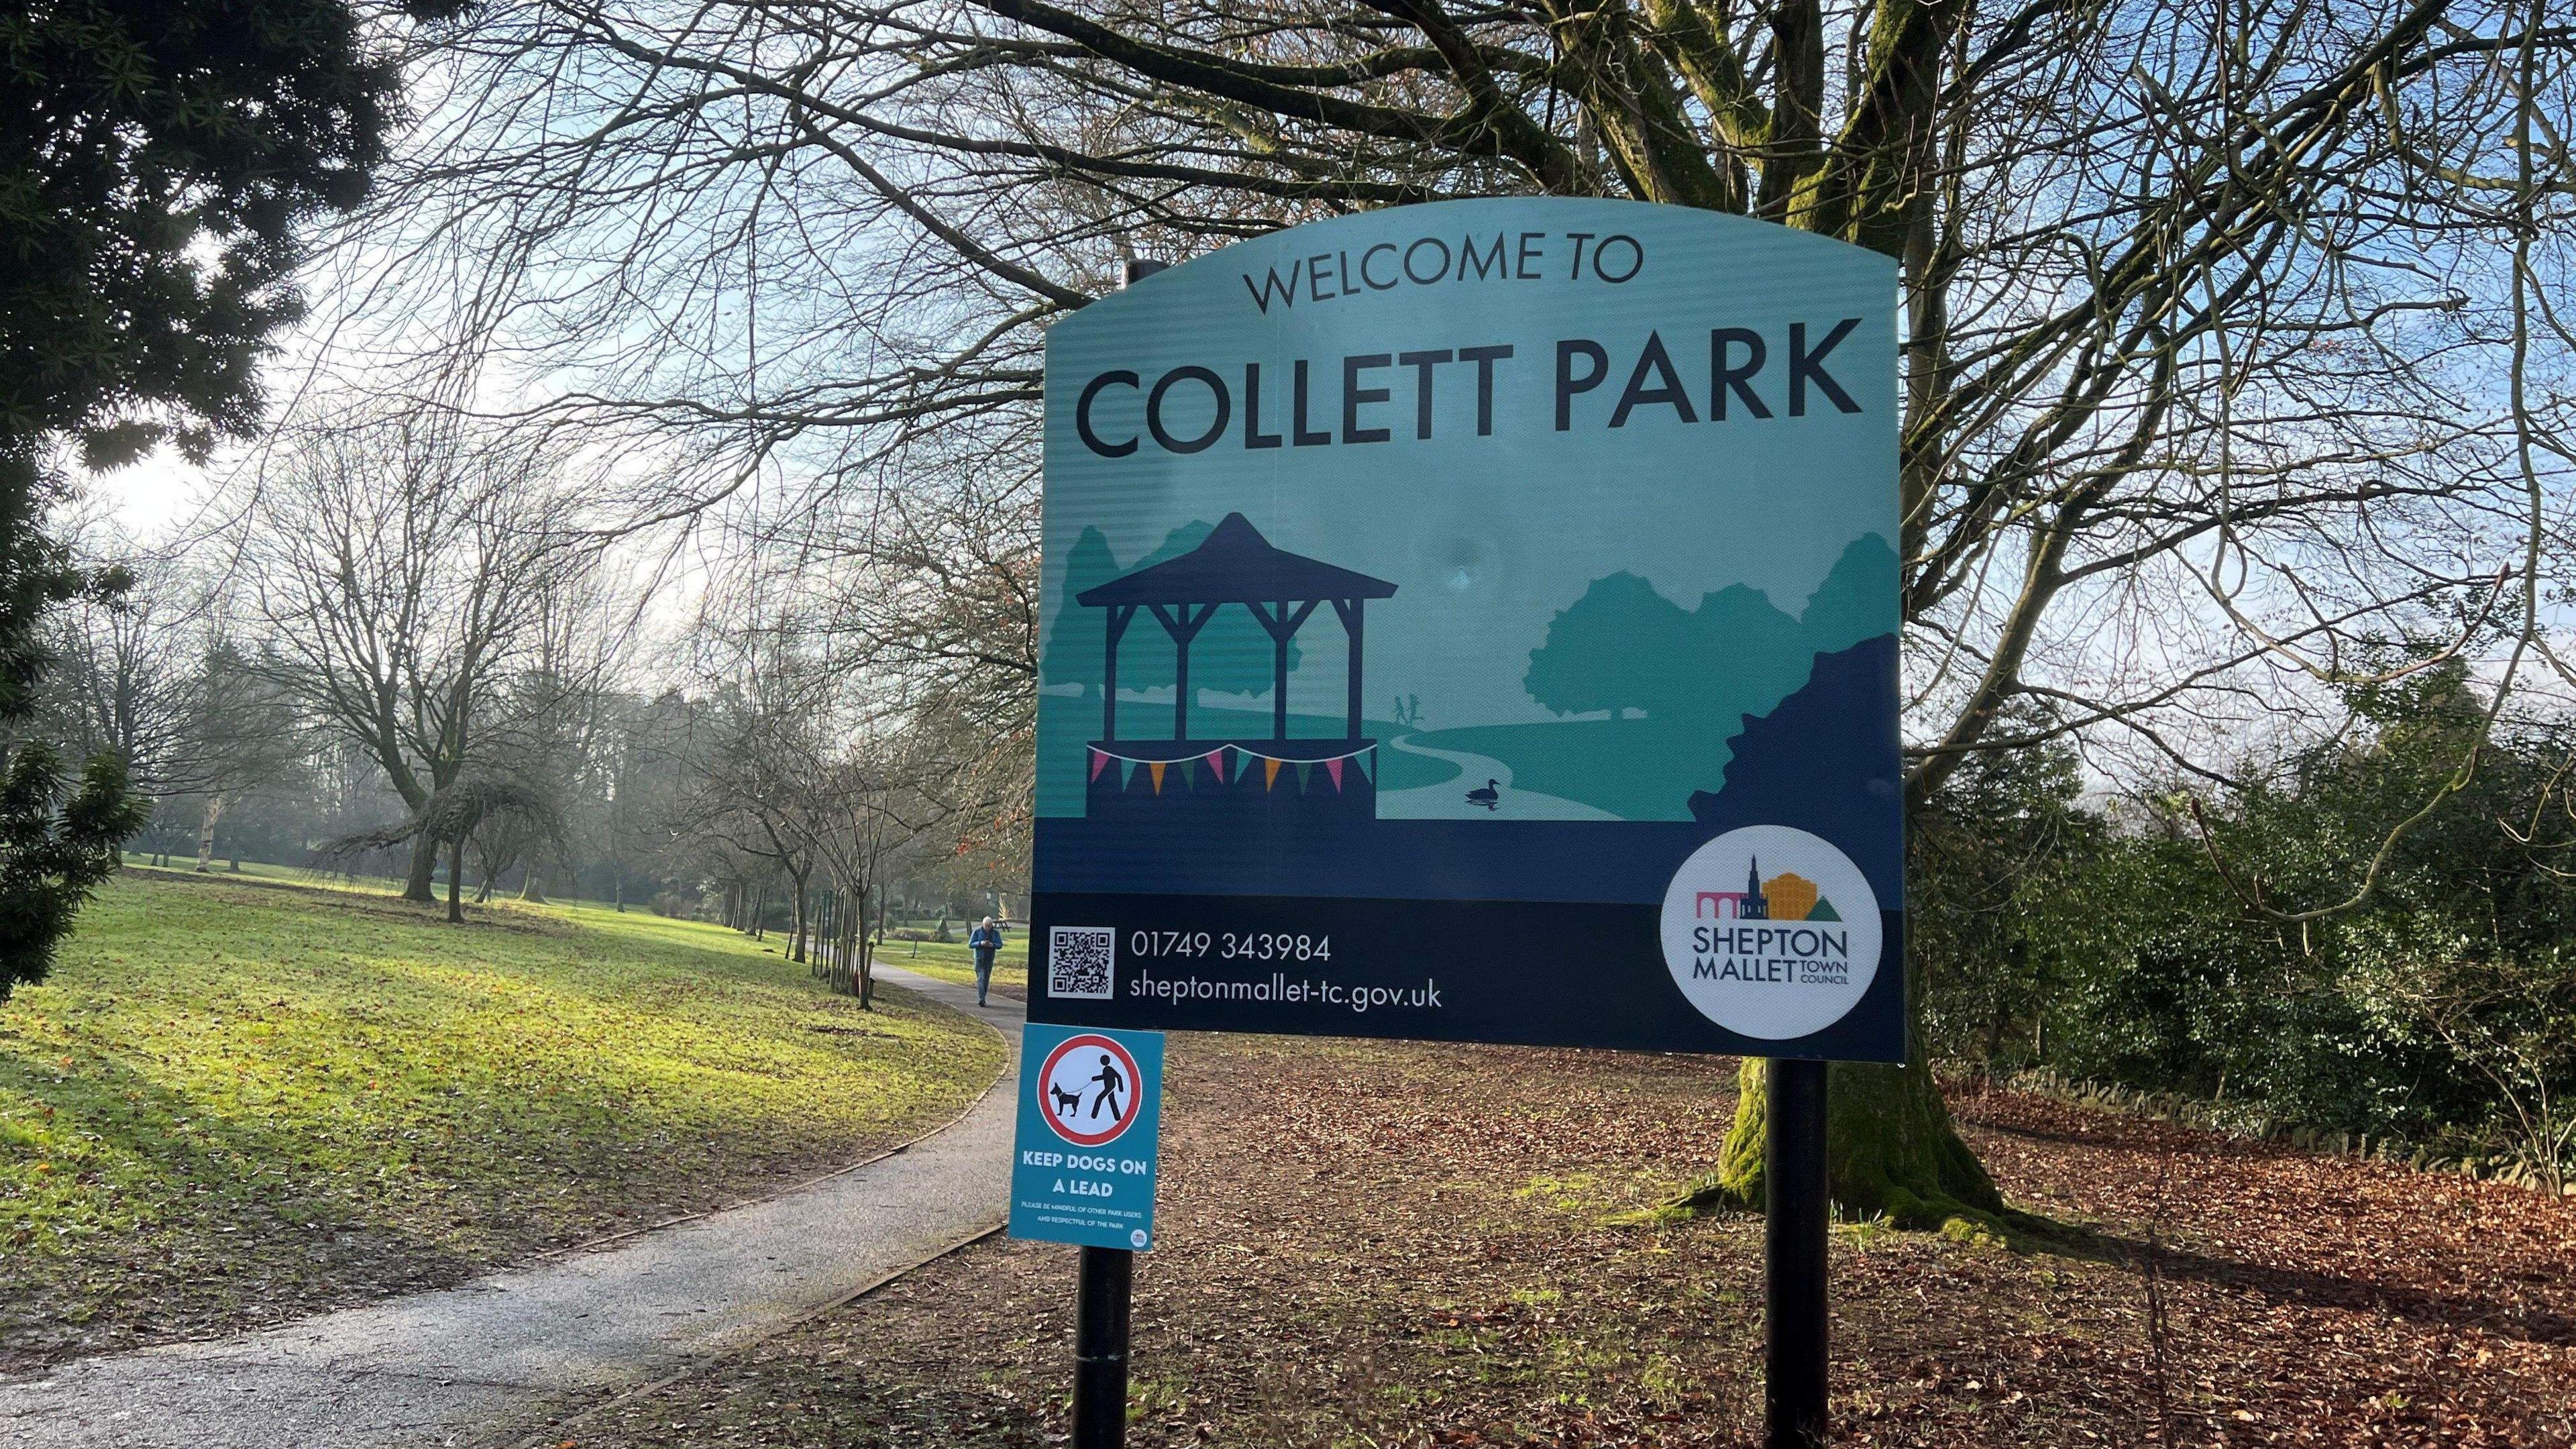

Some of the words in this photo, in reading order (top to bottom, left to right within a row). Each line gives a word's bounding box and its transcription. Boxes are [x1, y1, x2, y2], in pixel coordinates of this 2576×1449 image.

[1242, 231, 1546, 316] WELCOME
[1566, 232, 1644, 284] TO
[1075, 344, 1514, 458] COLLETT
[1555, 317, 1863, 433] PARK
[1131, 930, 1211, 957] 01749
[1221, 932, 1331, 961] 343984
[1692, 926, 1848, 958] SHEPTON
[1693, 956, 1797, 983] MALLET
[1799, 960, 1848, 974] TOWN
[1801, 974, 1849, 985] COUNCIL
[1130, 969, 1442, 1012] sheptonmallet-tc.gov.uk
[1023, 1150, 1063, 1167] KEEP
[1067, 1155, 1116, 1173] DOGS
[1120, 1159, 1147, 1176] ON
[1053, 1178, 1065, 1193] A
[1069, 1179, 1113, 1197] LEAD
